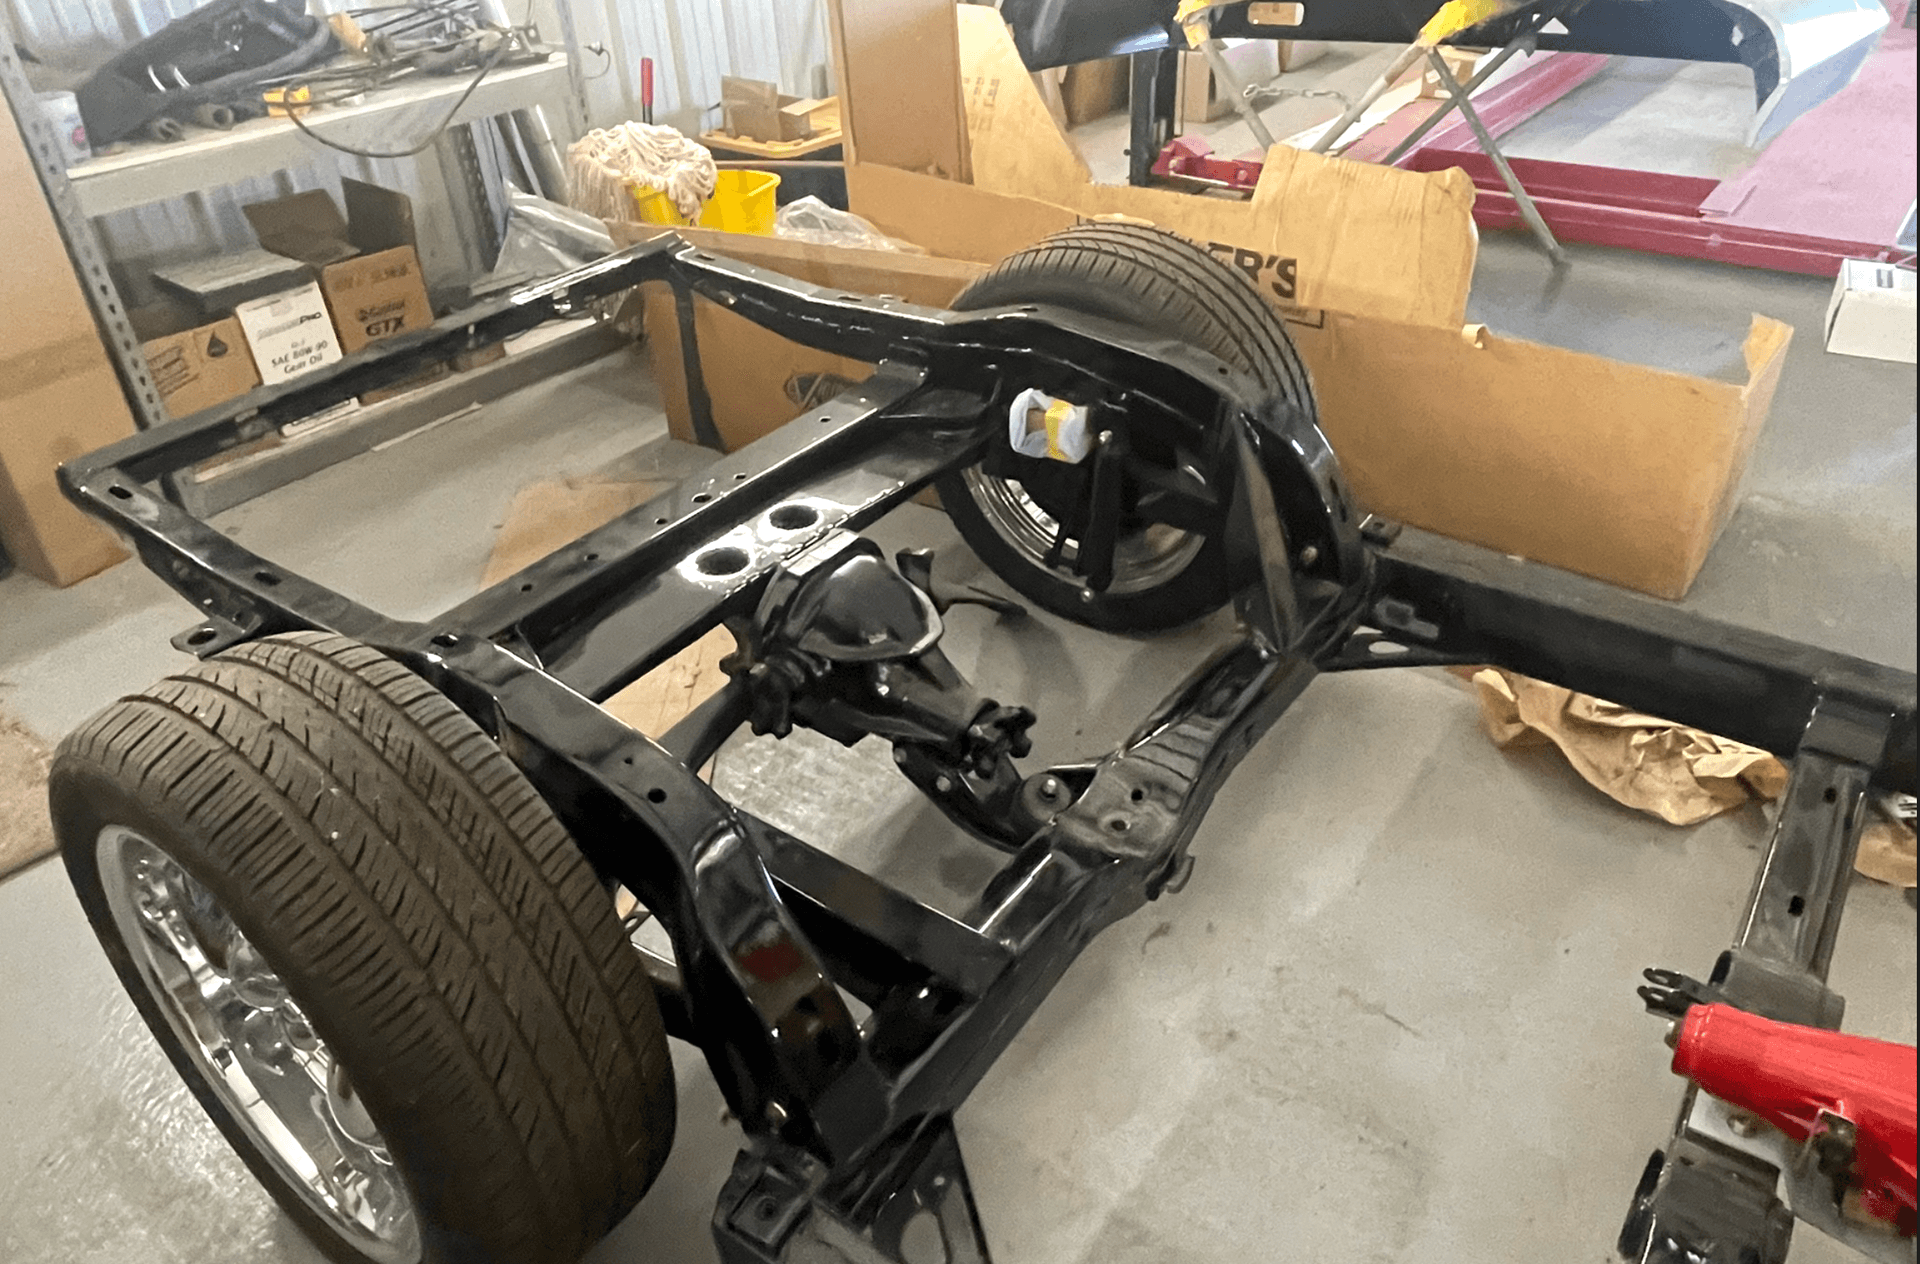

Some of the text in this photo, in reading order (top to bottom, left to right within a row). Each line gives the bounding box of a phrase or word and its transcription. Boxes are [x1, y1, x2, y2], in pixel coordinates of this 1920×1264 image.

[366, 315, 404, 336] GTX
[271, 353, 290, 367] SAE
[309, 352, 323, 364] Oil
